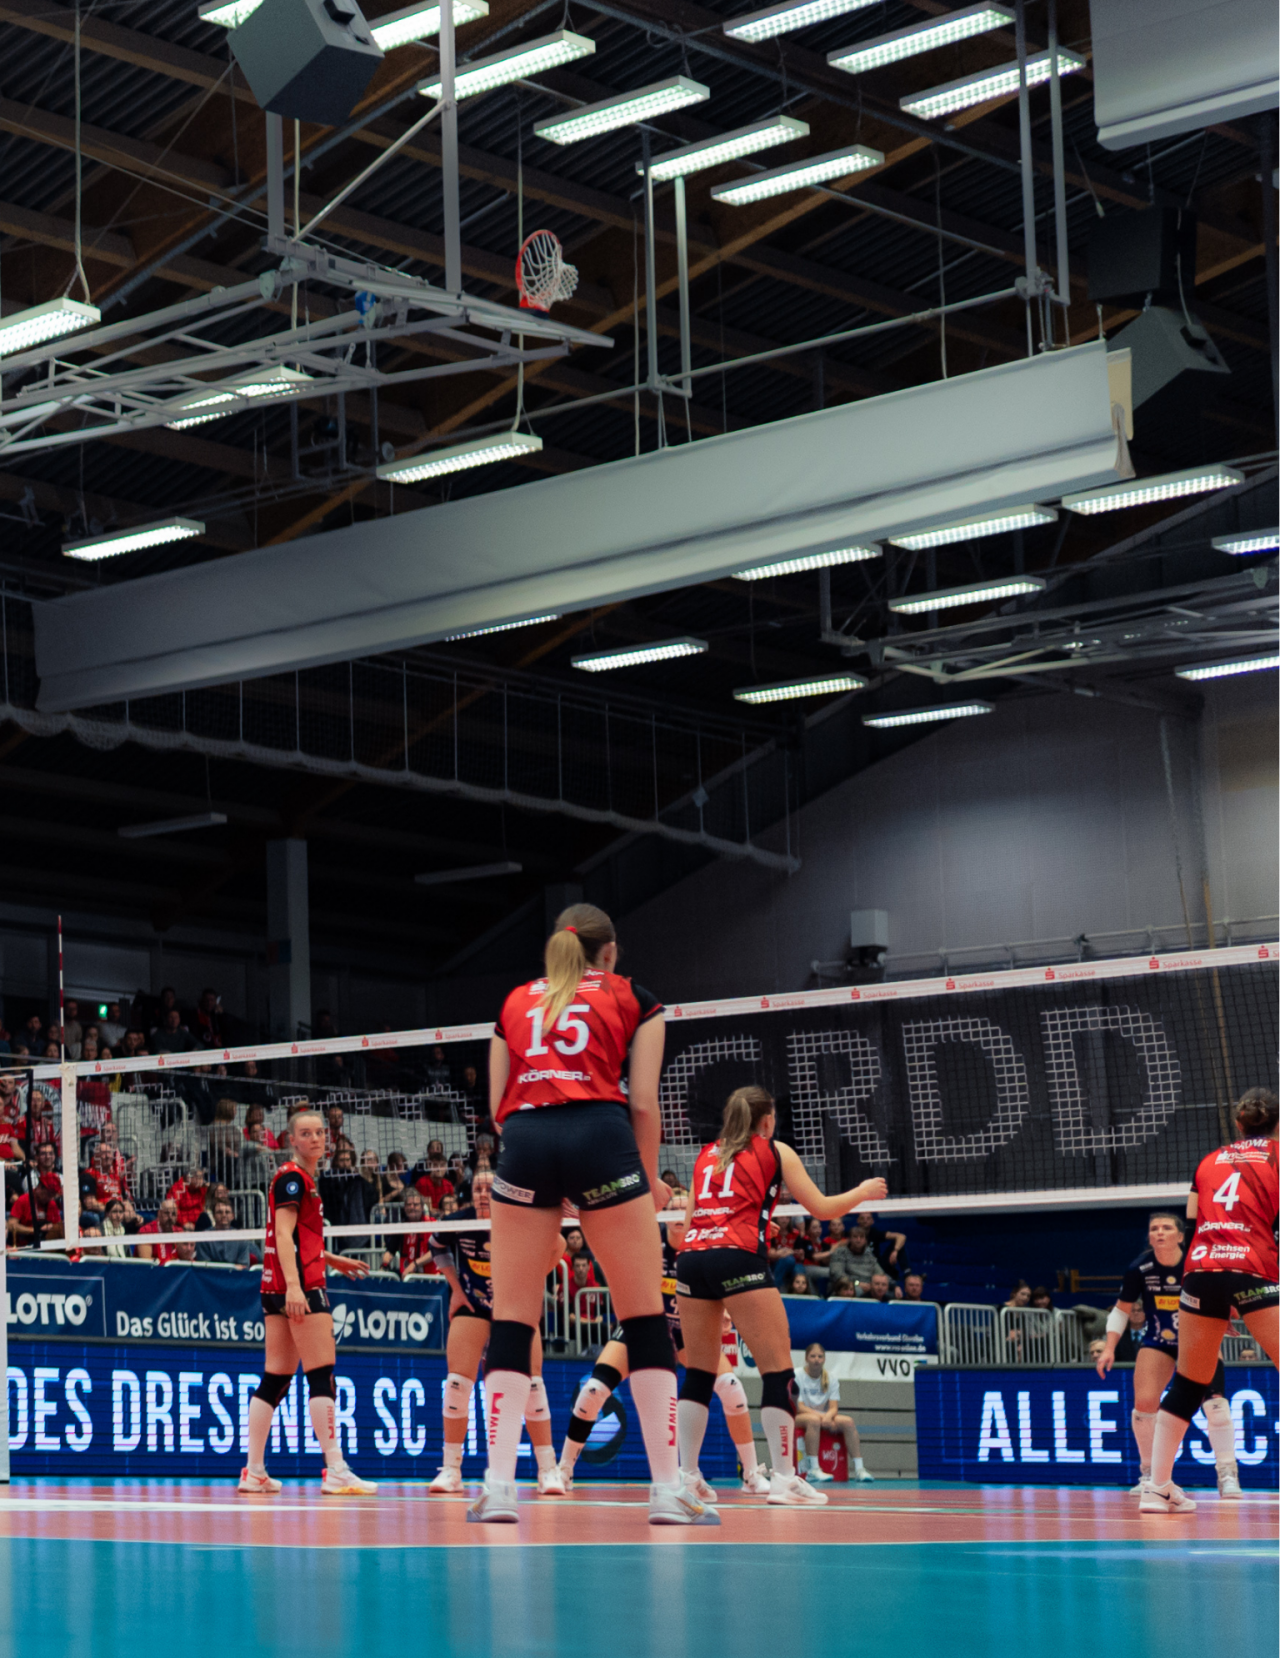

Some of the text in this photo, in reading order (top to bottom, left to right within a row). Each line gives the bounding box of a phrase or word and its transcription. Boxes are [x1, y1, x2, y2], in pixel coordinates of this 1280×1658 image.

[1162, 957, 1203, 969] Sparkasse
[1058, 969, 1096, 980] Sparkasse
[958, 979, 995, 990] Sparkasse
[863, 989, 898, 1000] Sparkasse
[773, 999, 805, 1008] Sparkasse
[685, 1007, 717, 1016] Sparkasse
[525, 1004, 590, 1057] 15
[698, 1162, 735, 1200] 11
[1213, 1171, 1241, 1211] 4
[1209, 1251, 1246, 1260] Energie
[1212, 1244, 1250, 1252] Sachsen
[116, 1311, 265, 1342] Das Glück ist so
[357, 1310, 428, 1341] LOTTO
[877, 1358, 911, 1376] VVO
[6, 1366, 94, 1452] DES
[372, 1376, 426, 1456] SC
[978, 1391, 1122, 1463] ALLE
